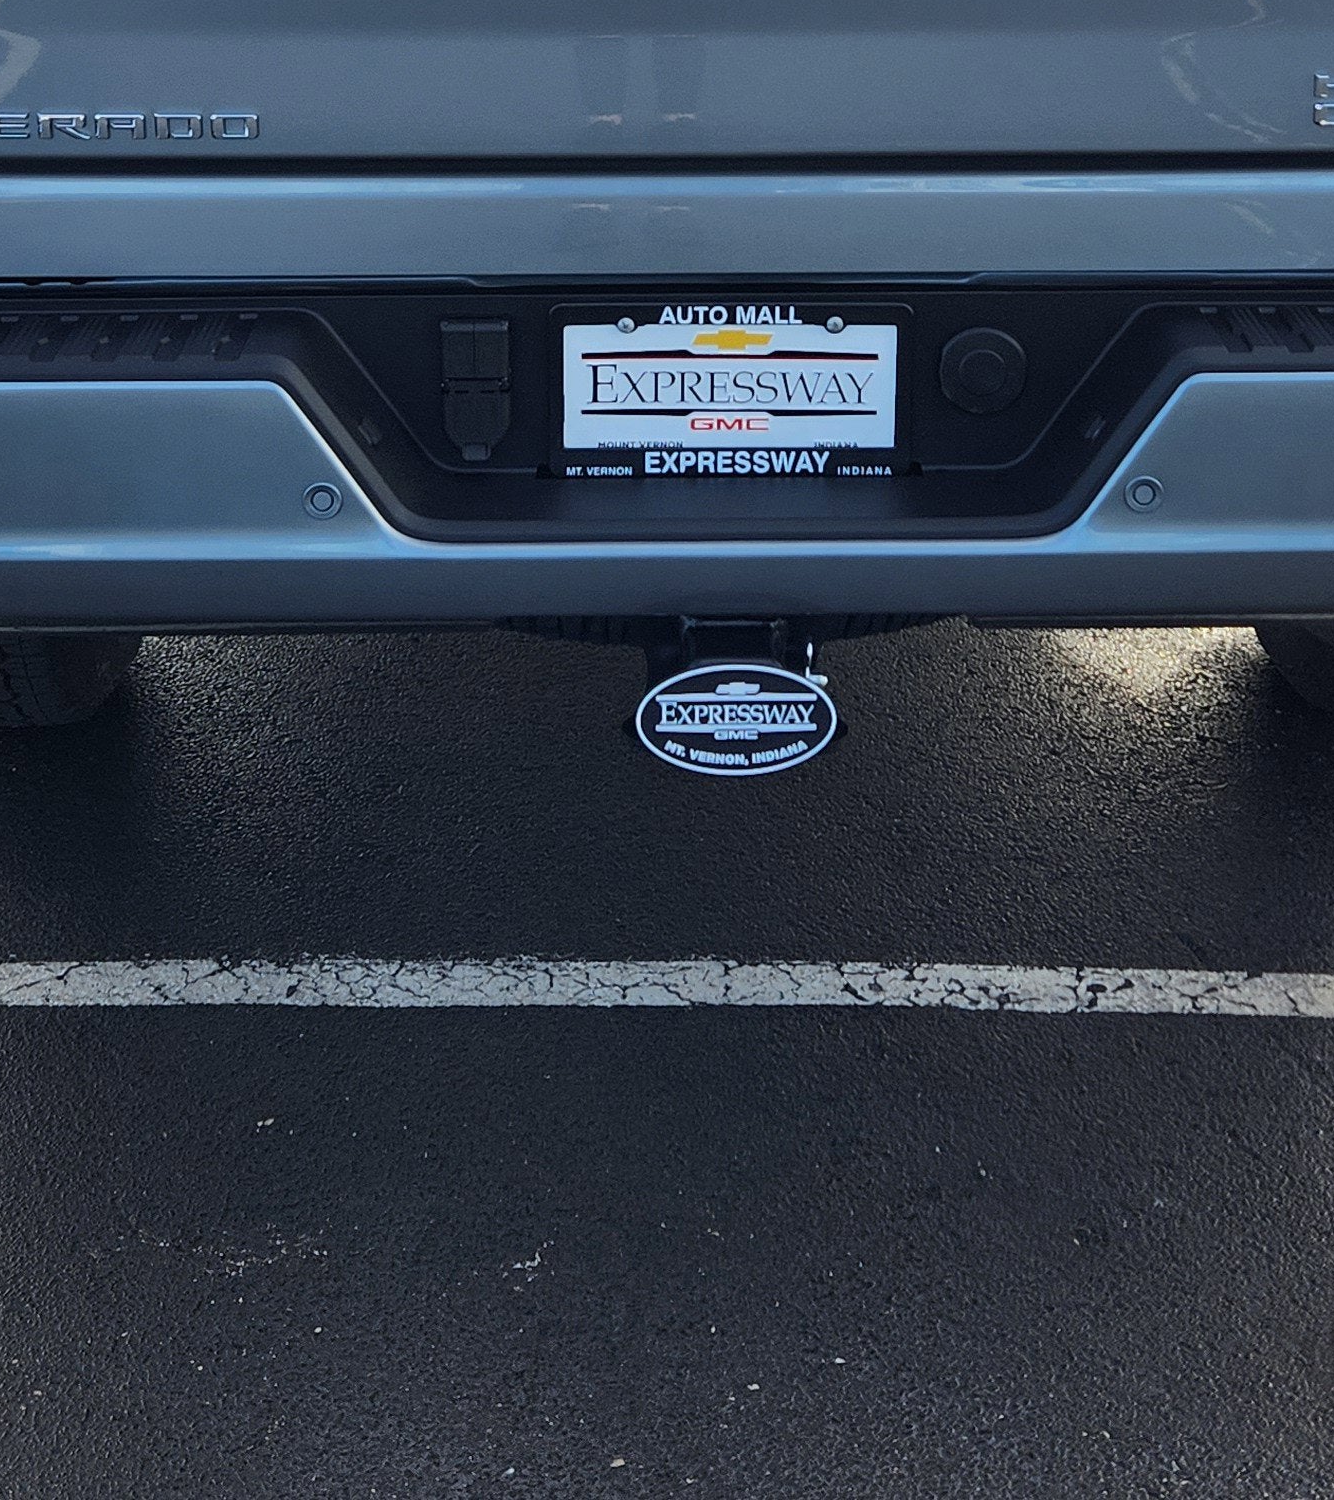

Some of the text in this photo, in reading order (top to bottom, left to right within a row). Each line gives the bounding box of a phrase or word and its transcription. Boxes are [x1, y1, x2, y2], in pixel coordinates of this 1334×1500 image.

[658, 305, 803, 325] AUTO MALL
[586, 363, 874, 405] EXPRESSWAY
[689, 417, 770, 431] GMC
[597, 440, 684, 449] MOUNT VERNON
[644, 450, 830, 474] EXPRESSWAY
[566, 466, 633, 476] MT. VERNON
[837, 466, 893, 476] INDIANA
[658, 701, 815, 725] EXPRESSWAY
[713, 729, 760, 741] GMC
[663, 739, 809, 767] MT. VERNON, INDIANA
